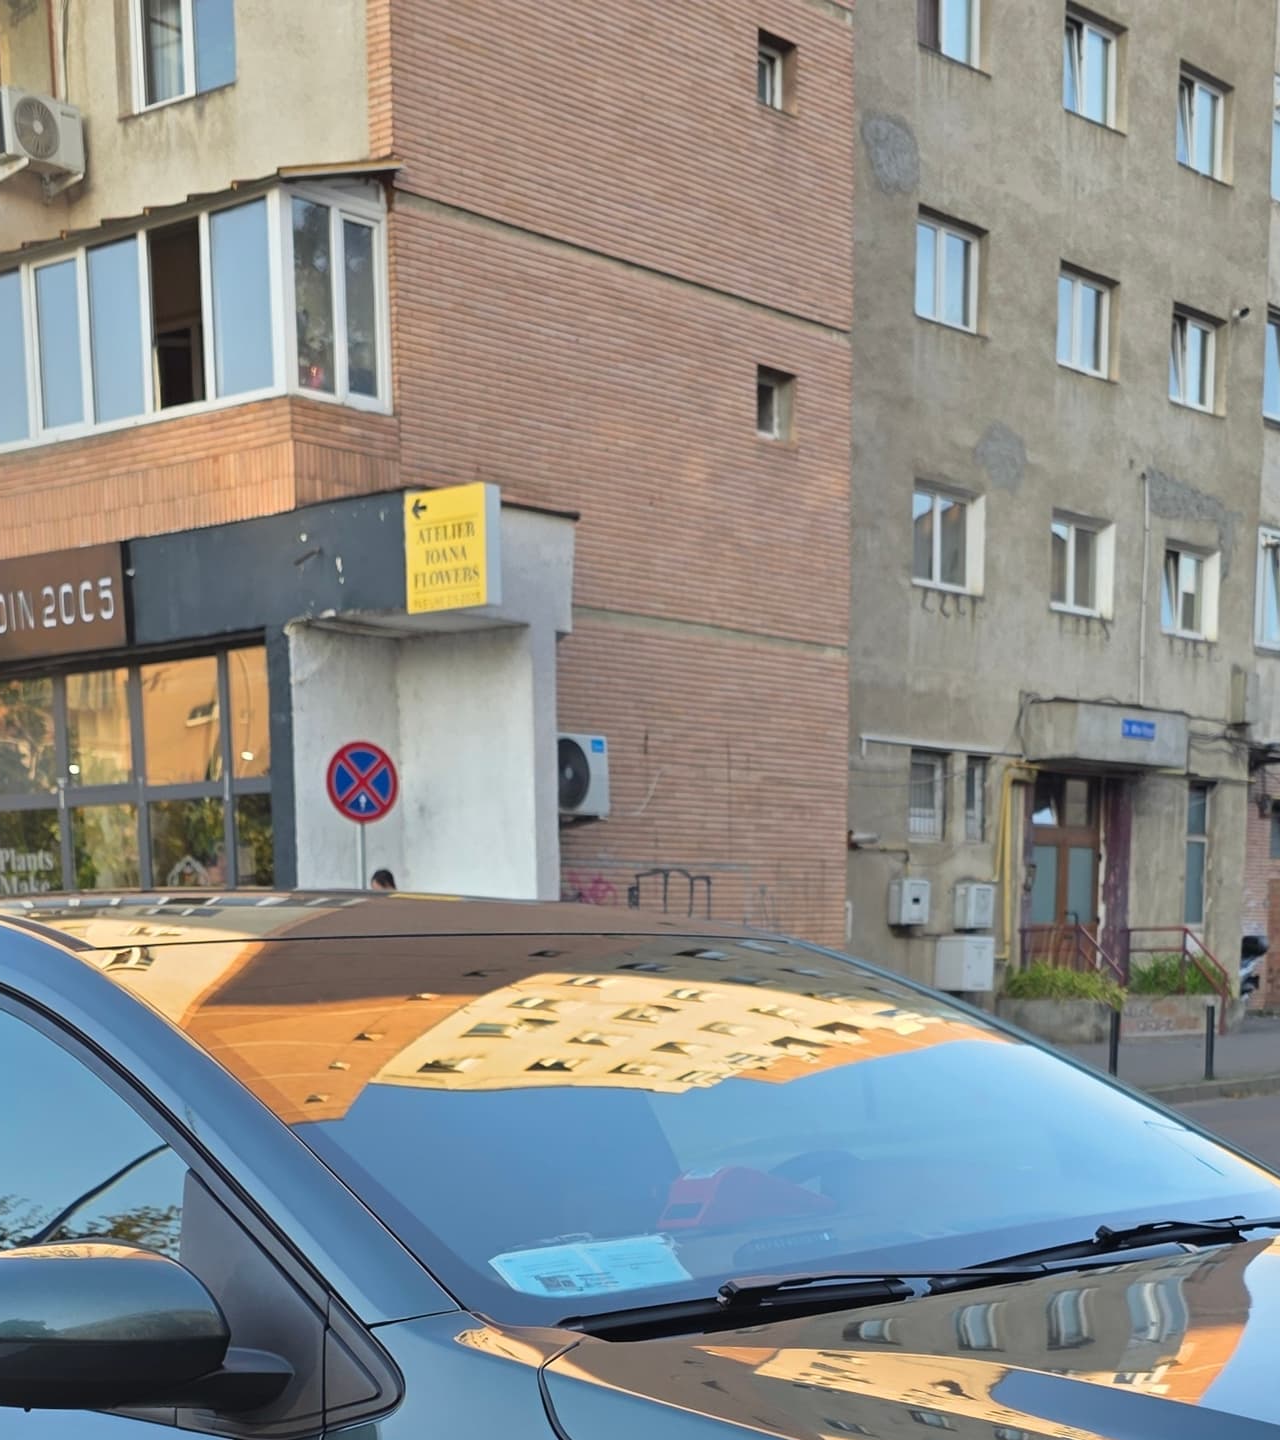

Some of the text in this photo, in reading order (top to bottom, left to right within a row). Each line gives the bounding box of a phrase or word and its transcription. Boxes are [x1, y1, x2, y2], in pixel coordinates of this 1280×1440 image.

[416, 520, 475, 545] ATELIER
[425, 545, 468, 566] IOANA
[413, 565, 480, 590] FLOWERS
